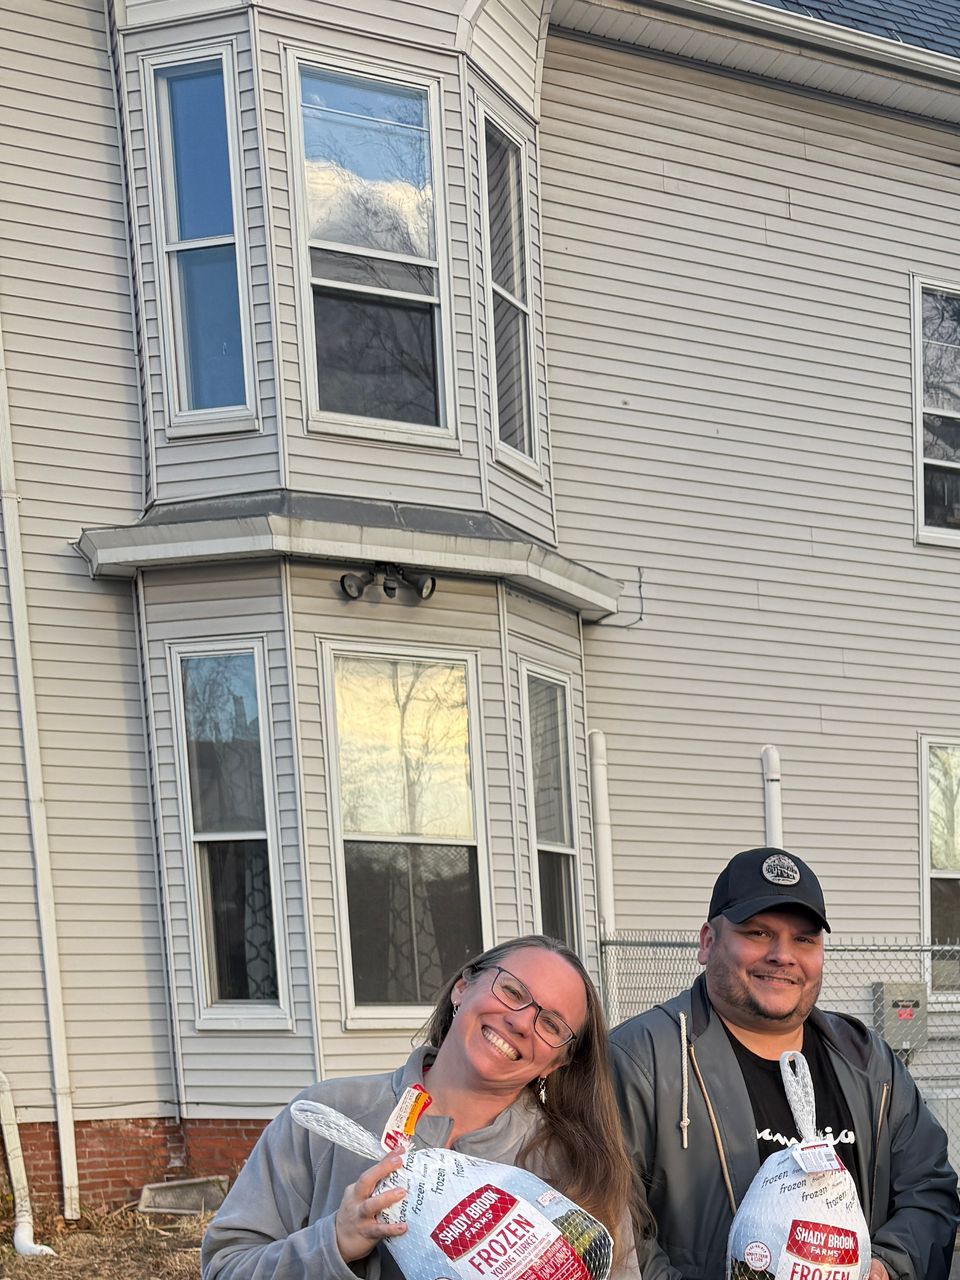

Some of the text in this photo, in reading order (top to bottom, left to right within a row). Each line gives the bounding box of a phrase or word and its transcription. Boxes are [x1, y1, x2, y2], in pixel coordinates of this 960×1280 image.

[431, 1168, 446, 1195] frozen
[761, 1170, 789, 1188] frozen
[780, 1179, 807, 1194] frozen
[412, 1182, 425, 1216] frozen
[801, 1186, 828, 1202] frozen
[826, 1191, 847, 1209] frozen
[438, 1190, 500, 1245] SHADY BROOK
[468, 1213, 535, 1275] FROZEN
[795, 1226, 855, 1250] SHADY BROOK
[491, 1254, 517, 1278] YOUNG
[513, 1232, 539, 1258] TURKEY
